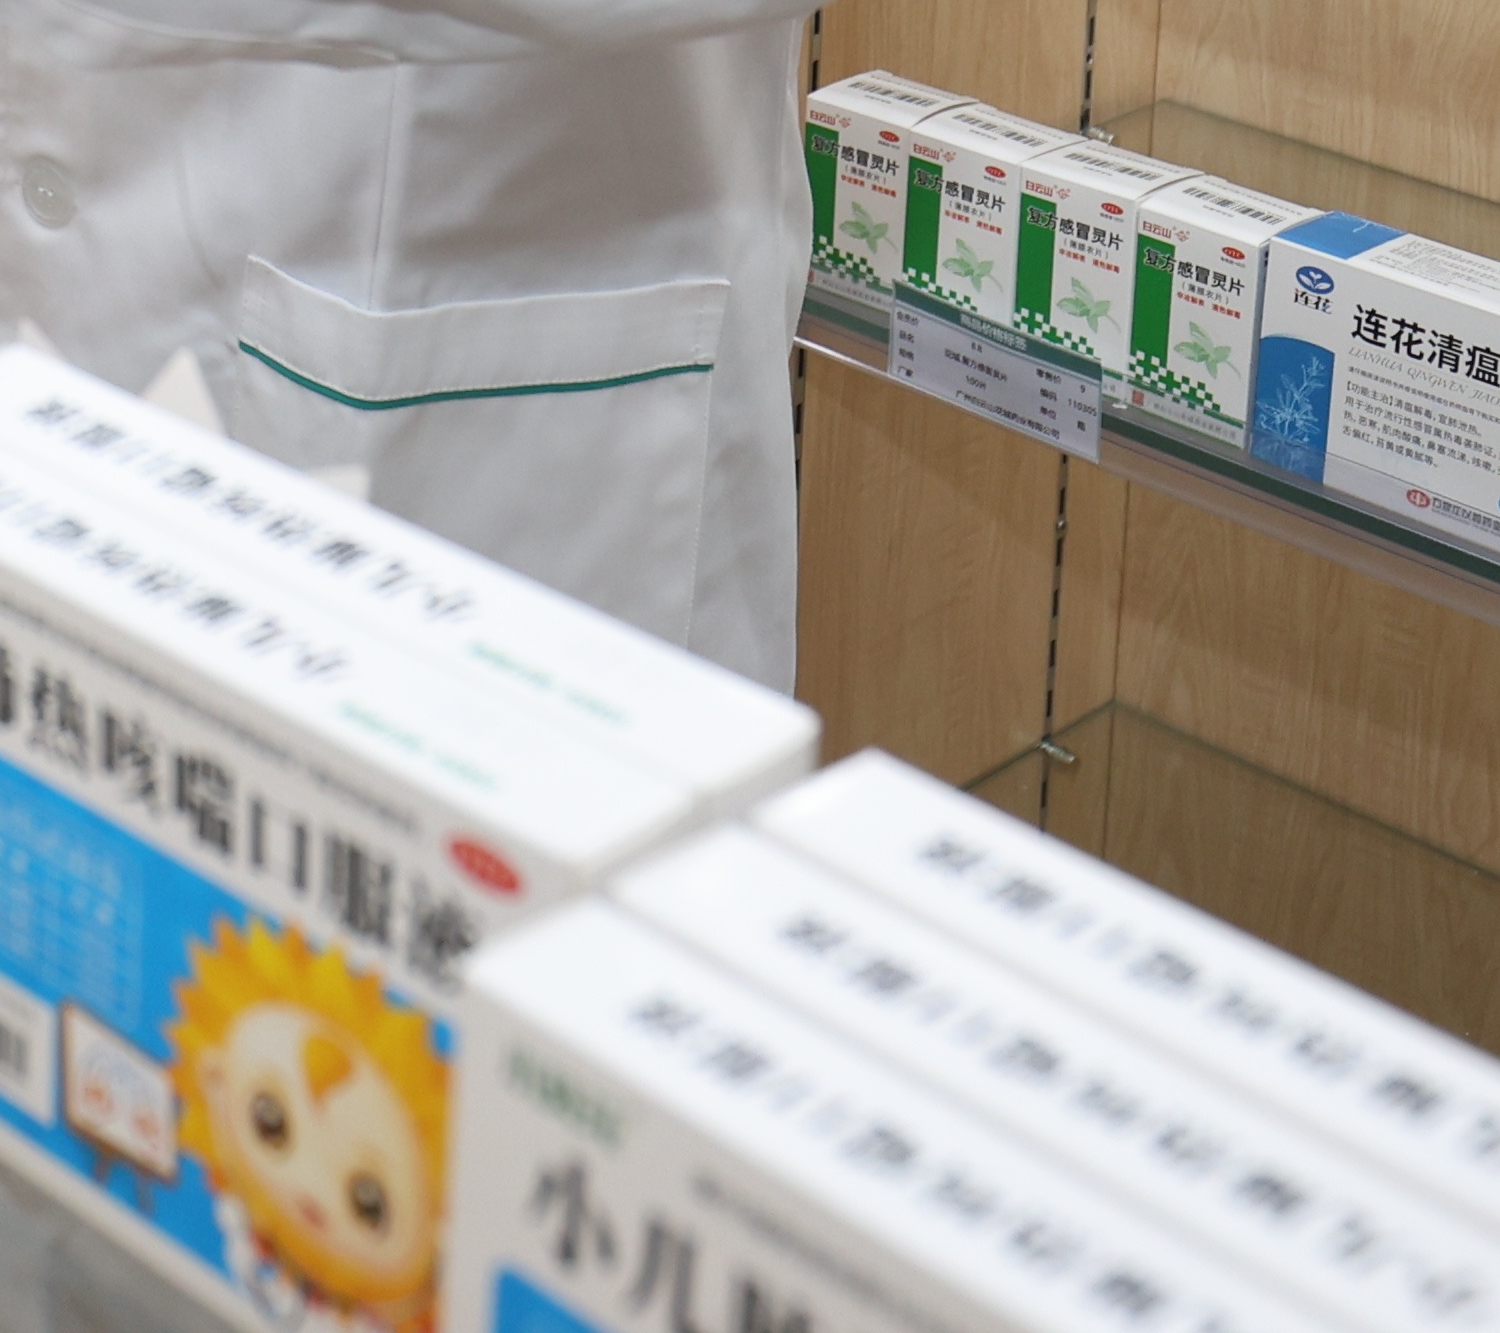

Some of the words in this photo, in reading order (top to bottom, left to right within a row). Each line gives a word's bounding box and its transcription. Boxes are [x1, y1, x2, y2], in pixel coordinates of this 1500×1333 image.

[811, 135, 900, 177] 复方感冒灵片
[915, 169, 1006, 214] 复方感冒灵片
[1026, 207, 1124, 252] 复方感冒灵片
[1143, 248, 1245, 297] 复方感冒灵片
[1293, 290, 1334, 315] 连花
[1348, 346, 1404, 374] LIANHUA
[1406, 366, 1469, 395] QINGWEN
